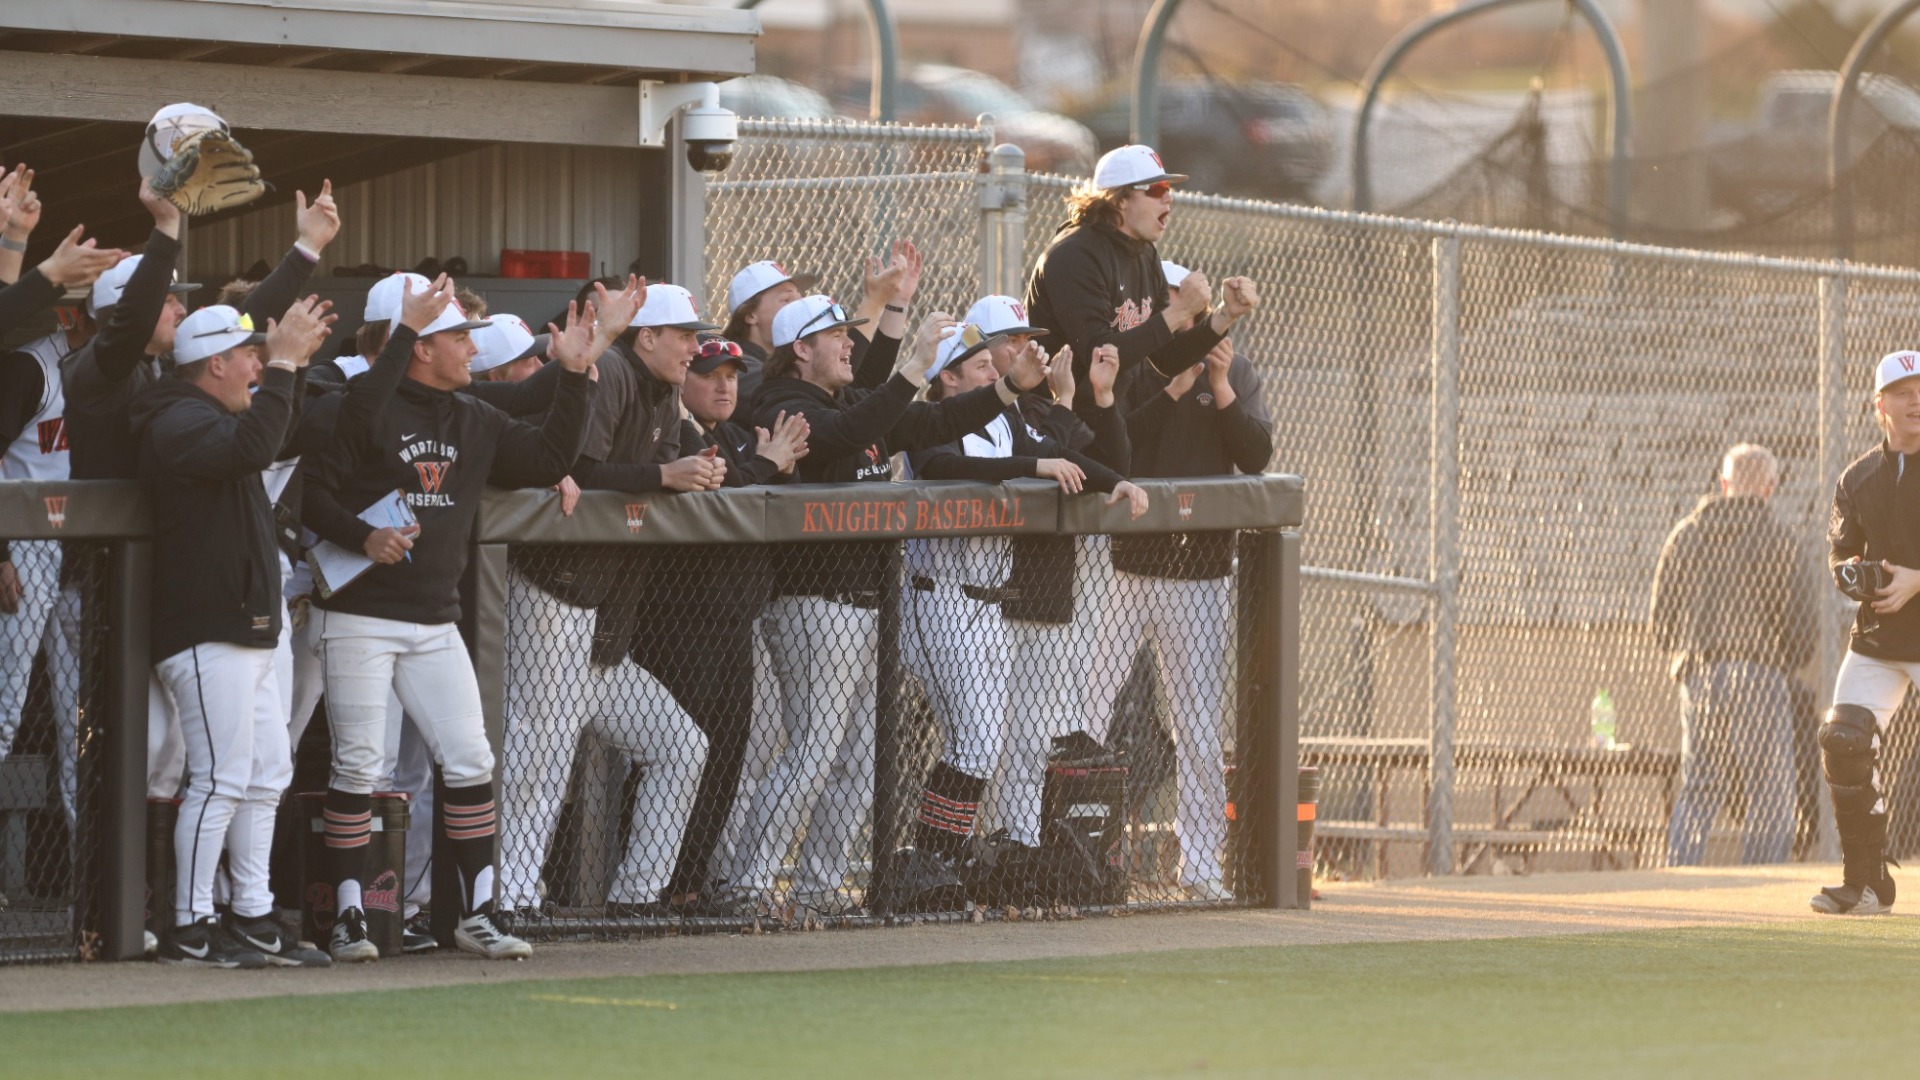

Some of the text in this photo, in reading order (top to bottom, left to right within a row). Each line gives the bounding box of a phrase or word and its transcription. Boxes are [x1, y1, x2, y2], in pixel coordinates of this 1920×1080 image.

[1897, 355, 1915, 372] W
[413, 461, 451, 494] W
[801, 497, 1025, 533] KNIGHTS BASEBALL
